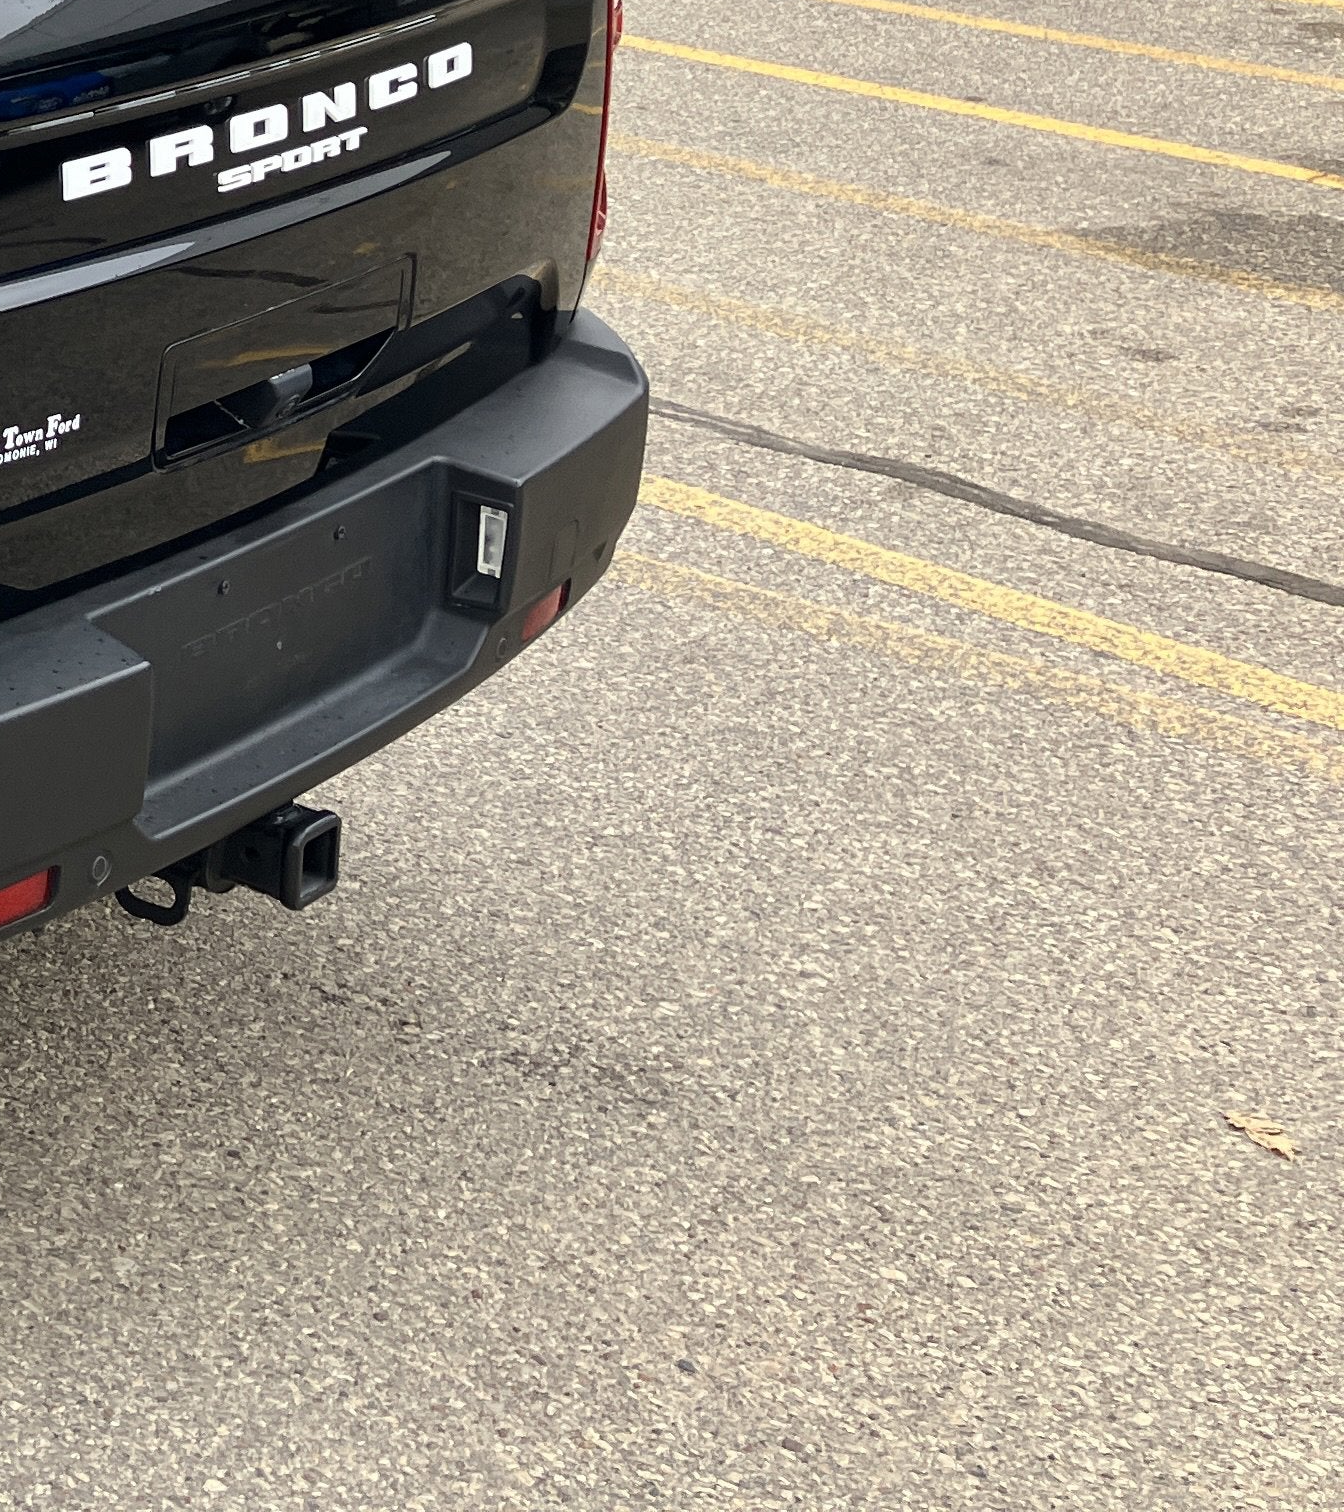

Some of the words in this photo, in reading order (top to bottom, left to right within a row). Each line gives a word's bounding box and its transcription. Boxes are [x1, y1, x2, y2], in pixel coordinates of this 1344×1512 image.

[60, 41, 474, 202] BRONCO
[217, 126, 368, 193] SPORT
[2, 425, 44, 450] Town
[45, 413, 81, 439] Ford
[44, 437, 58, 451] WI
